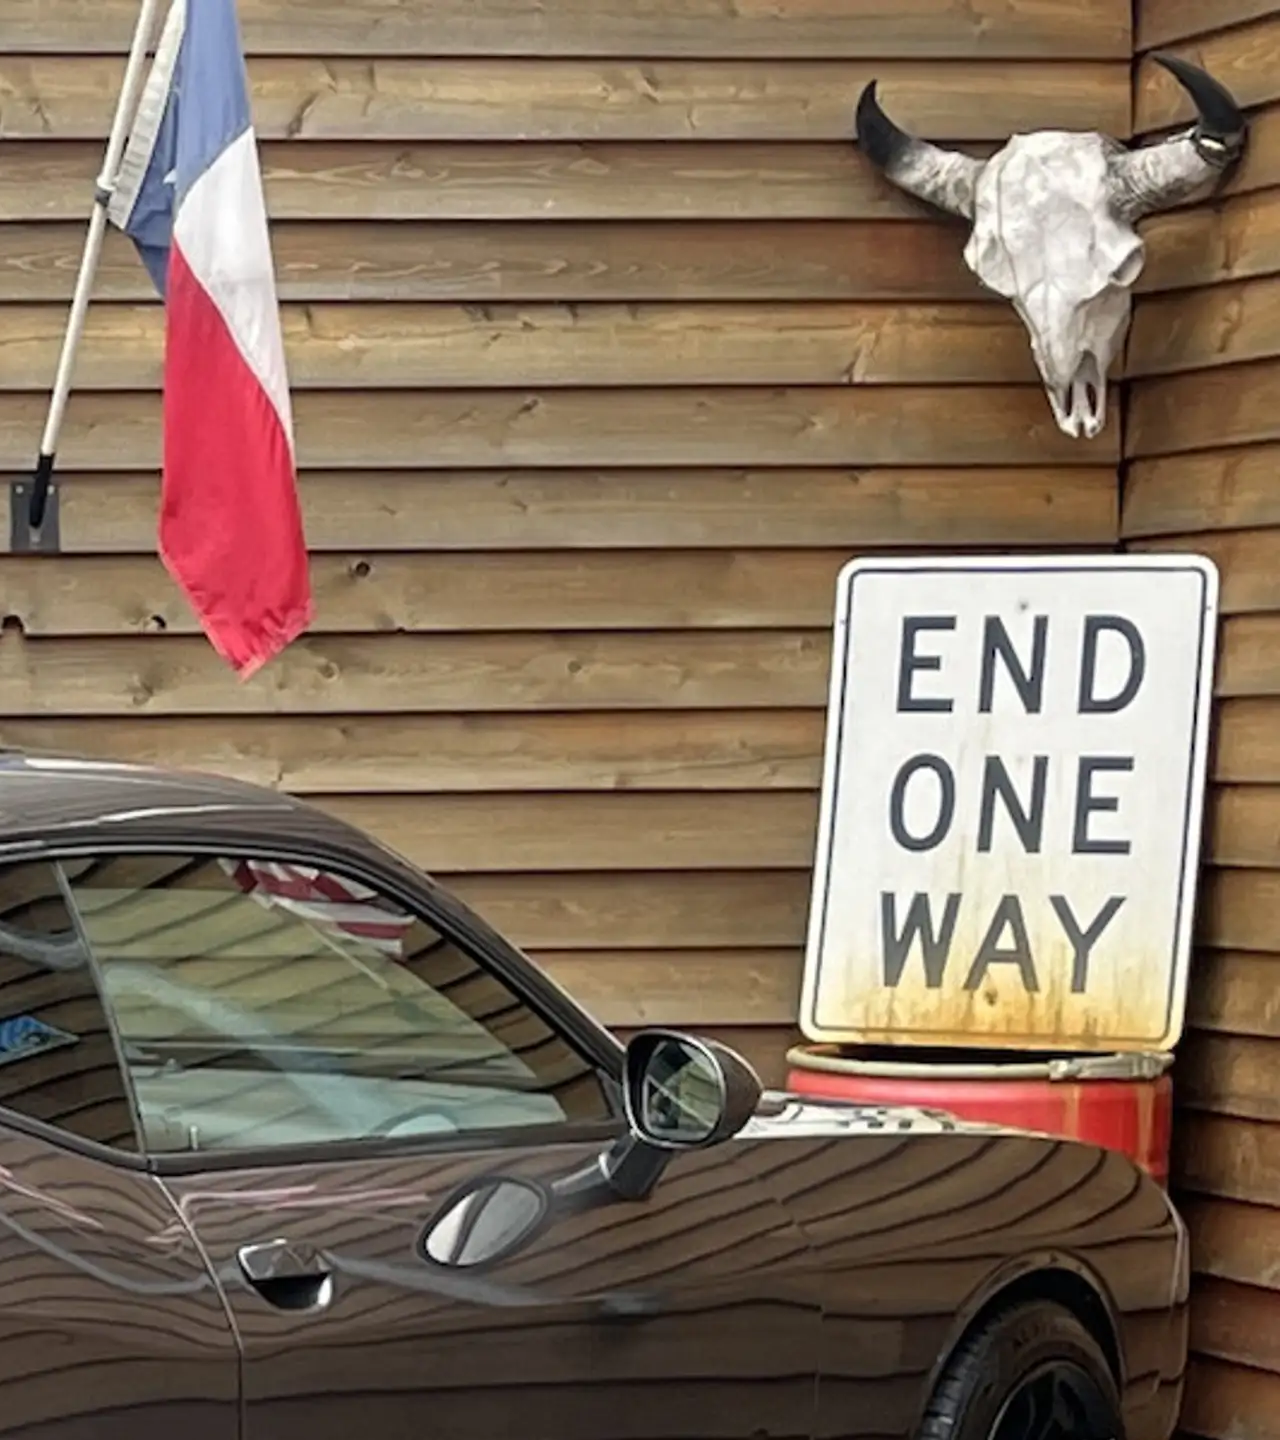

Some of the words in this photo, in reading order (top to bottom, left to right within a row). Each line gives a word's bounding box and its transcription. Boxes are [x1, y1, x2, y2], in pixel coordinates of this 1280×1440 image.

[897, 615, 1147, 714] END
[890, 753, 1135, 855] ONE
[880, 891, 1127, 994] WAY
